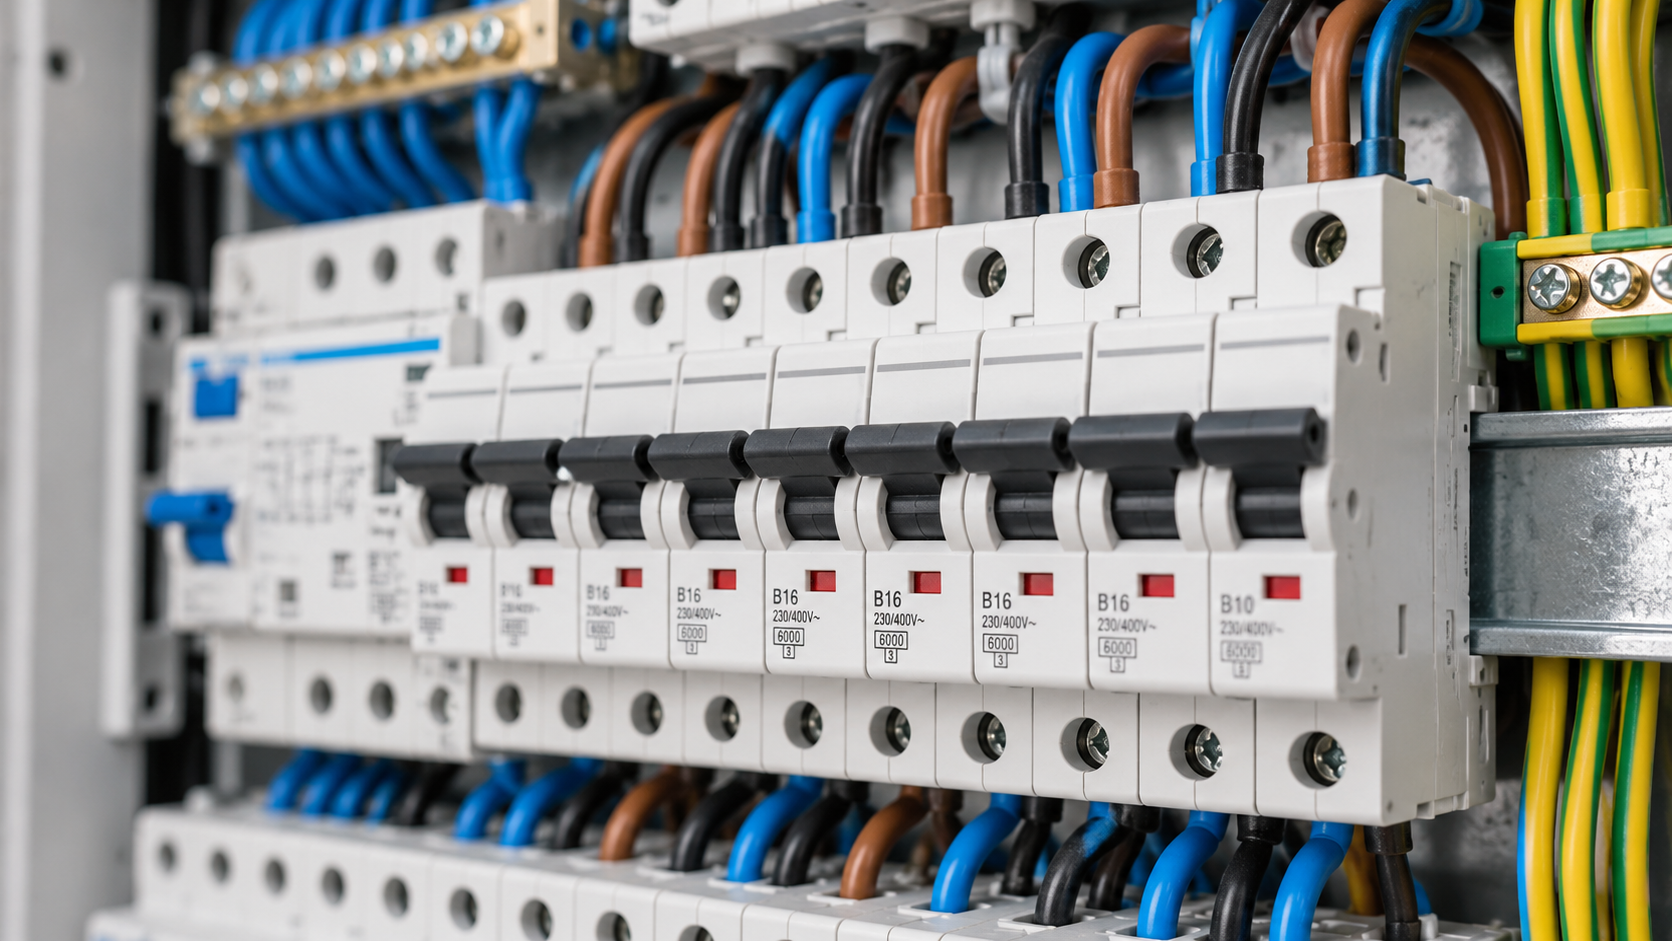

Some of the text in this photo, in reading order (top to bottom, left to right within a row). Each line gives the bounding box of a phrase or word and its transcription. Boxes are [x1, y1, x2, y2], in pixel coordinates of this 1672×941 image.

[587, 584, 609, 600] B16
[678, 587, 701, 603] B16
[773, 589, 798, 605] B16
[874, 590, 901, 607] B16
[983, 592, 1011, 609] B16
[1098, 593, 1129, 612] B16
[1221, 594, 1254, 614] B10
[773, 610, 820, 623] 230/400V~
[874, 612, 924, 626] 230/400V~
[982, 615, 1036, 629] 230/400V~
[1098, 617, 1157, 632] 230/400V~
[681, 626, 704, 639] 6000
[778, 629, 801, 643] 6000
[880, 634, 904, 647] 6000
[987, 637, 1014, 651] 6000
[1104, 640, 1132, 655] 6000
[786, 647, 792, 657] 3
[888, 650, 894, 660] 3
[997, 655, 1003, 665] 3
